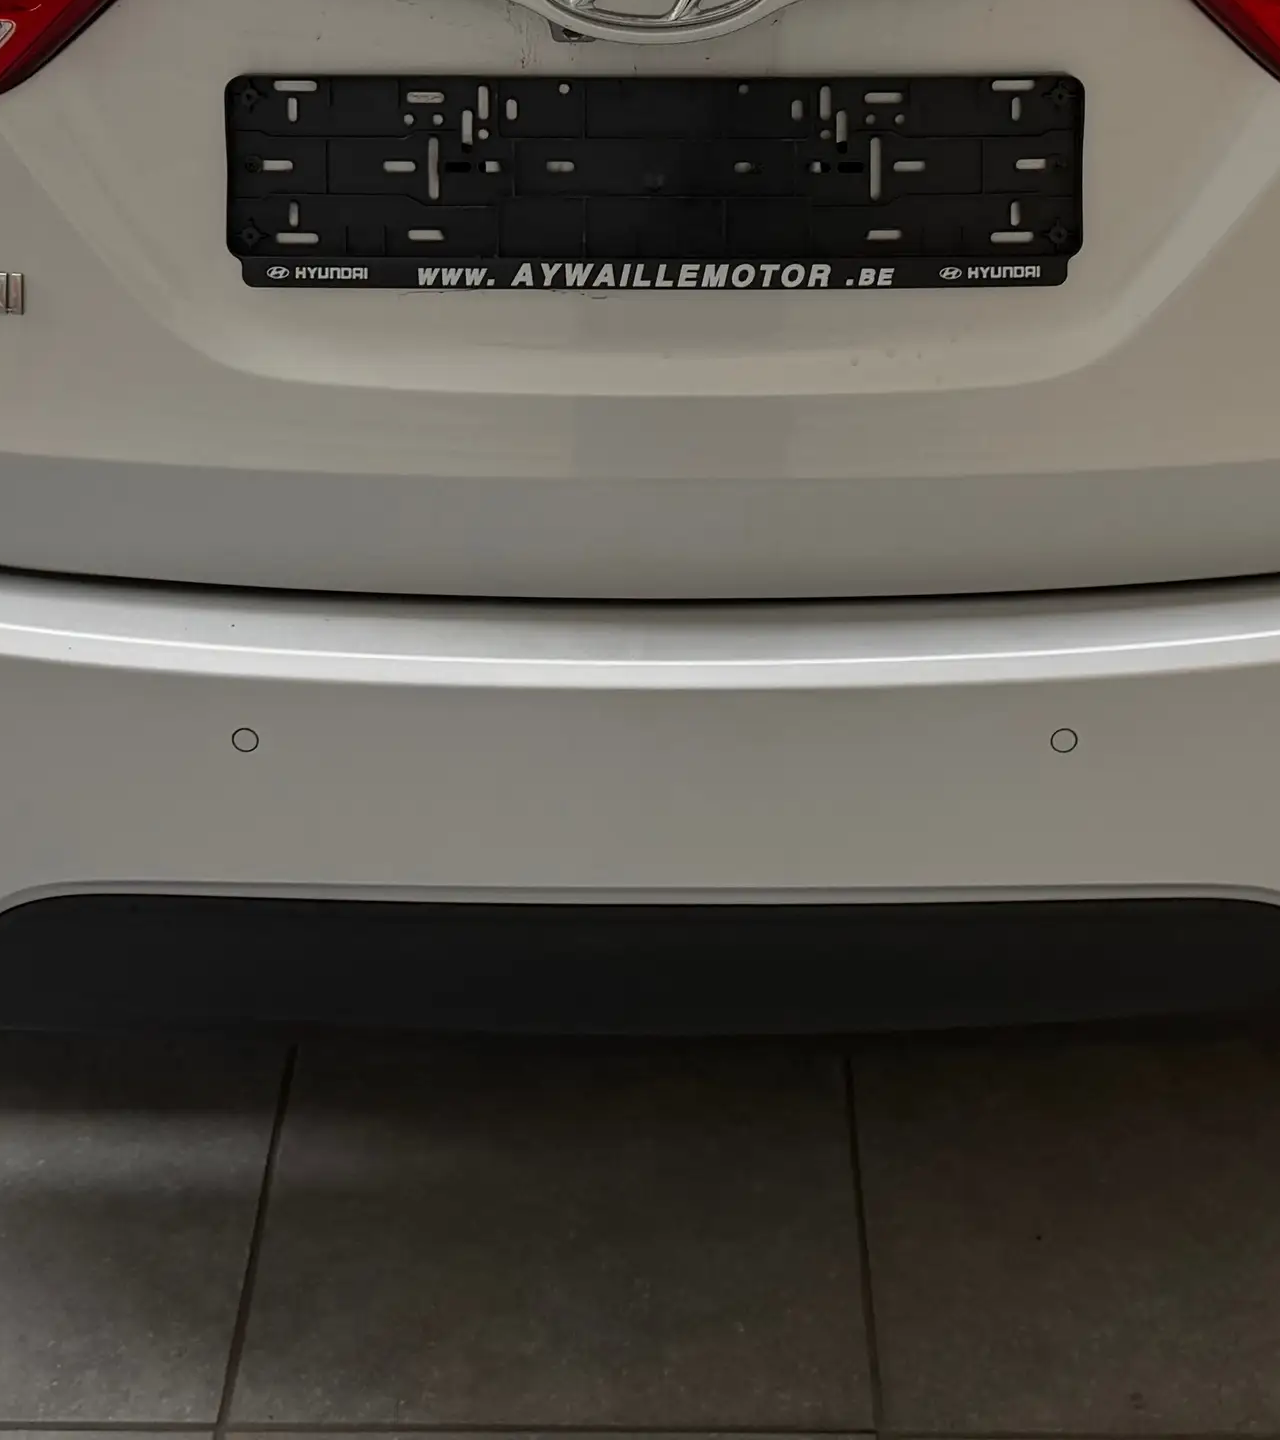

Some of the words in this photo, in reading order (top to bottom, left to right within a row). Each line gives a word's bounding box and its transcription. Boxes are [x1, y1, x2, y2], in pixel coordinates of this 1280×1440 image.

[295, 266, 369, 281] HYUNDAI
[511, 262, 832, 288] AYWAILLEMOTOR
[968, 265, 1041, 280] HYUNDAI
